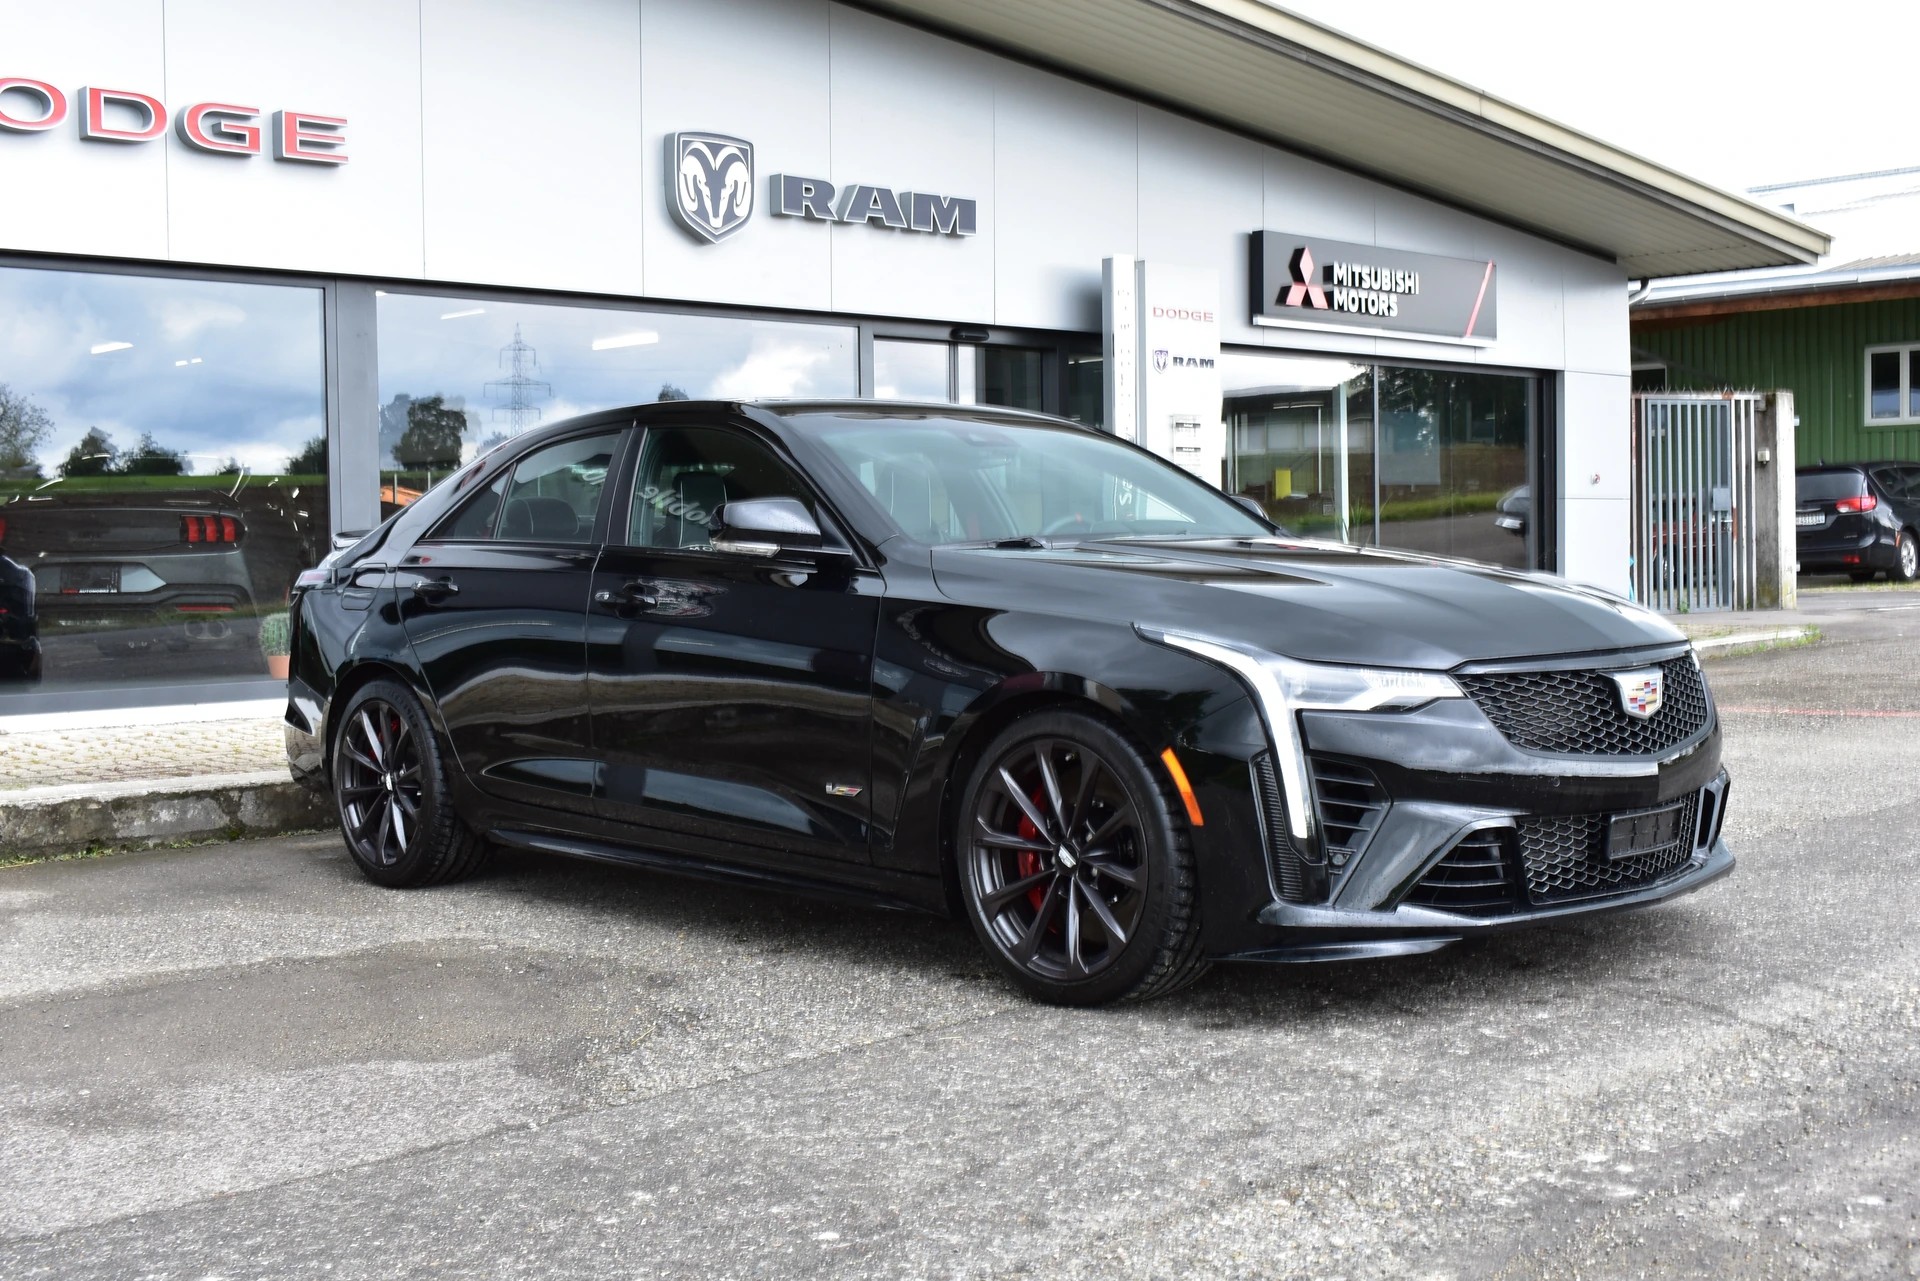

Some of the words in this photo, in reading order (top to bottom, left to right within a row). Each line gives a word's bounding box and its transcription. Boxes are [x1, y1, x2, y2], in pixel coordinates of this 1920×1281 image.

[770, 173, 977, 238] RAM
[1332, 260, 1420, 295] MITSUBISHI
[1152, 306, 1214, 323] DODGE
[1332, 286, 1399, 317] MOTORS
[1172, 356, 1215, 369] RAM
